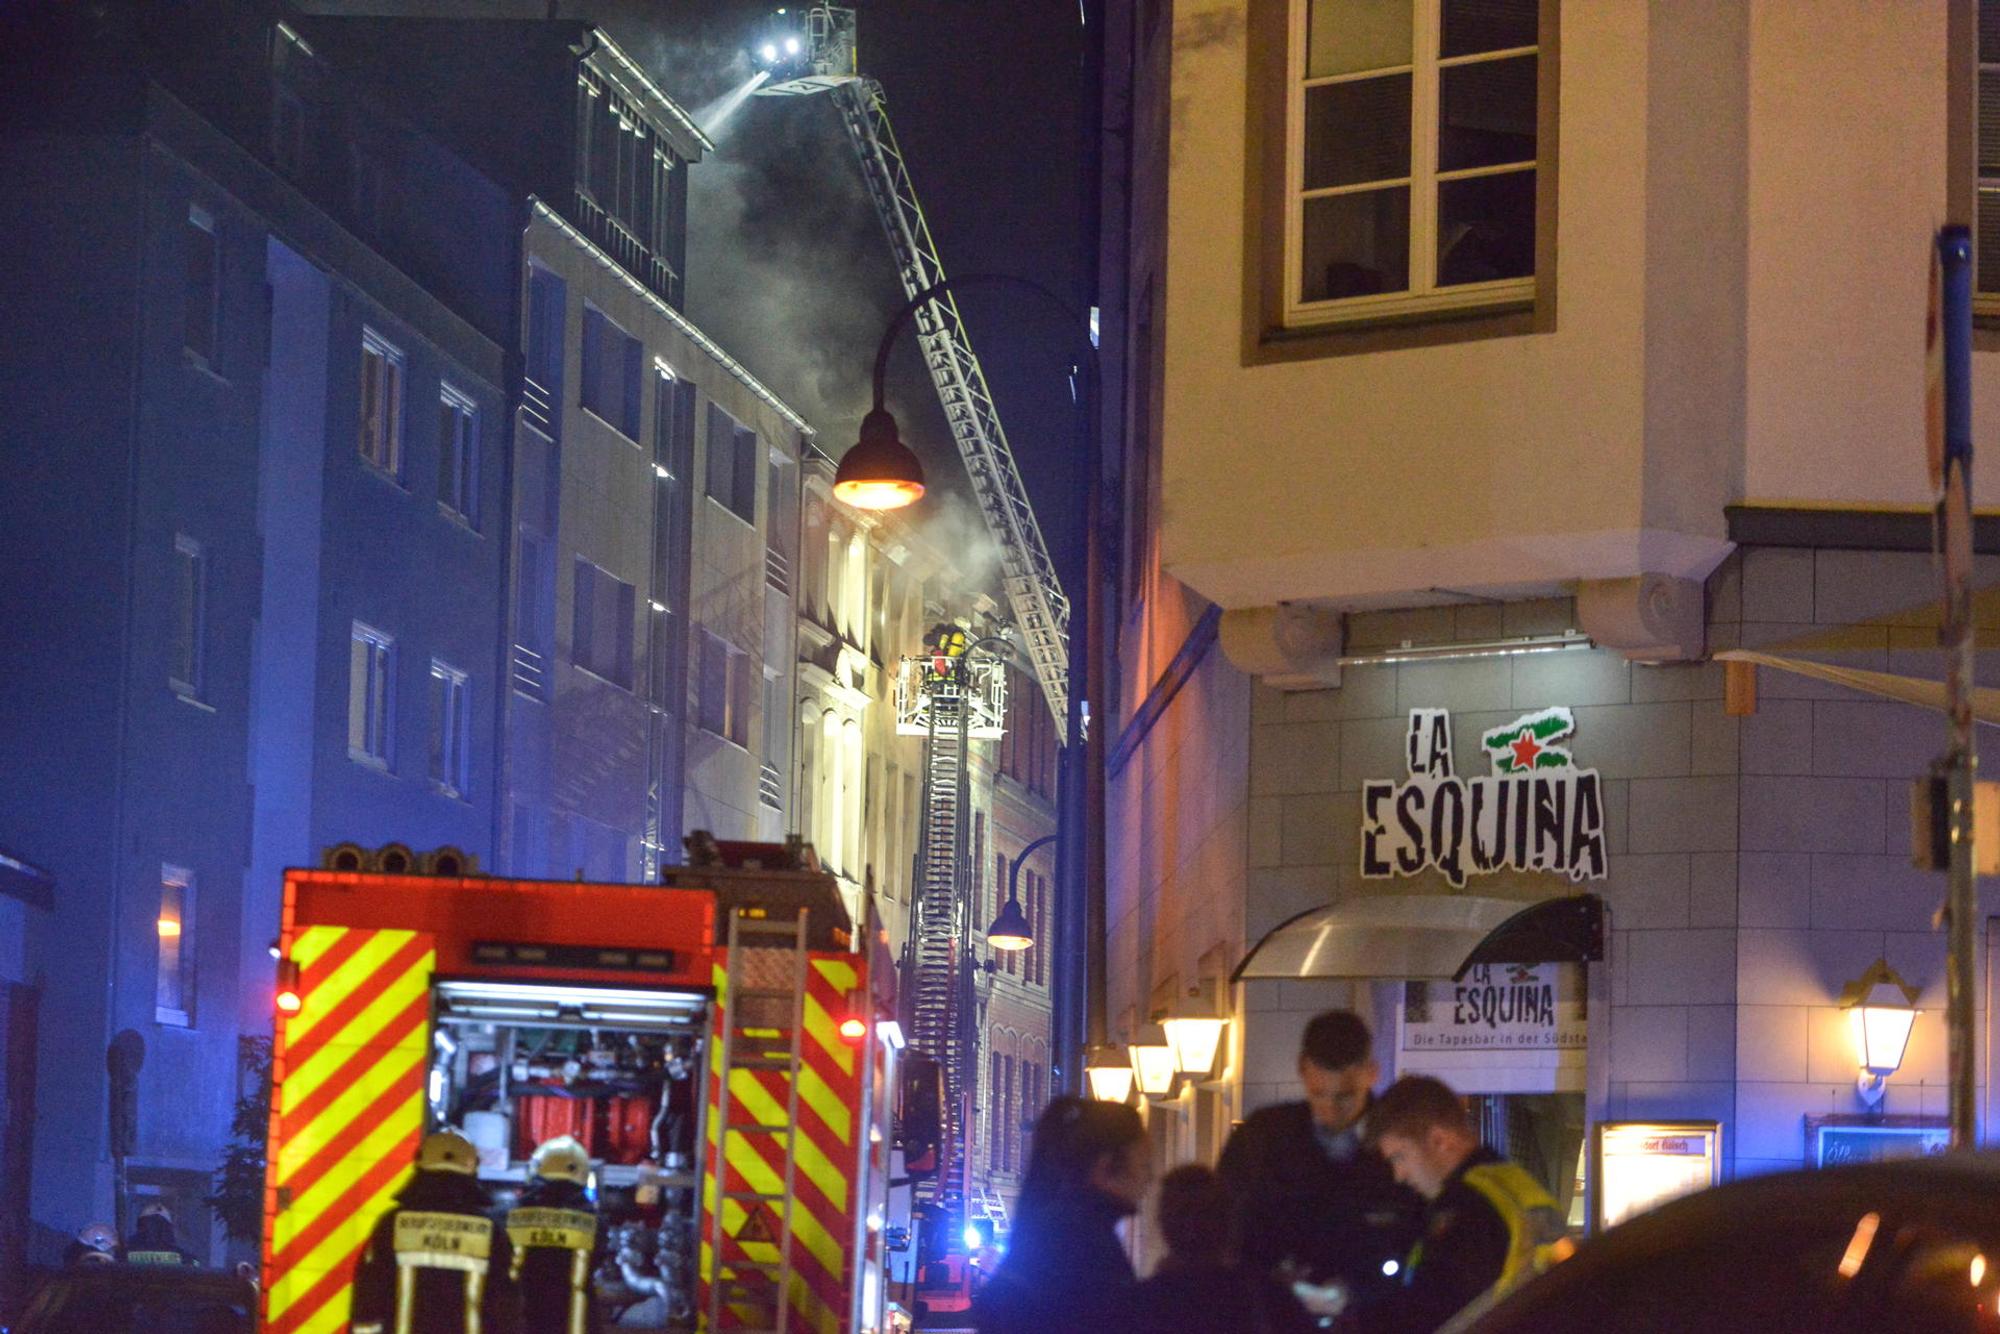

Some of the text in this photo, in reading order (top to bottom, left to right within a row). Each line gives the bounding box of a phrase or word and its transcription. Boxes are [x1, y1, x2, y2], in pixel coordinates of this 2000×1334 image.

[1410, 712, 1451, 778] LA
[1363, 773, 1607, 885] ESQUINA
[1454, 984, 1554, 1028] ESQUINA
[1413, 1034, 1434, 1045] Die
[1439, 1034, 1495, 1047] Tapasbar
[1500, 1033, 1512, 1044] in
[1518, 1033, 1538, 1044] der
[530, 1230, 567, 1244] KÖLN
